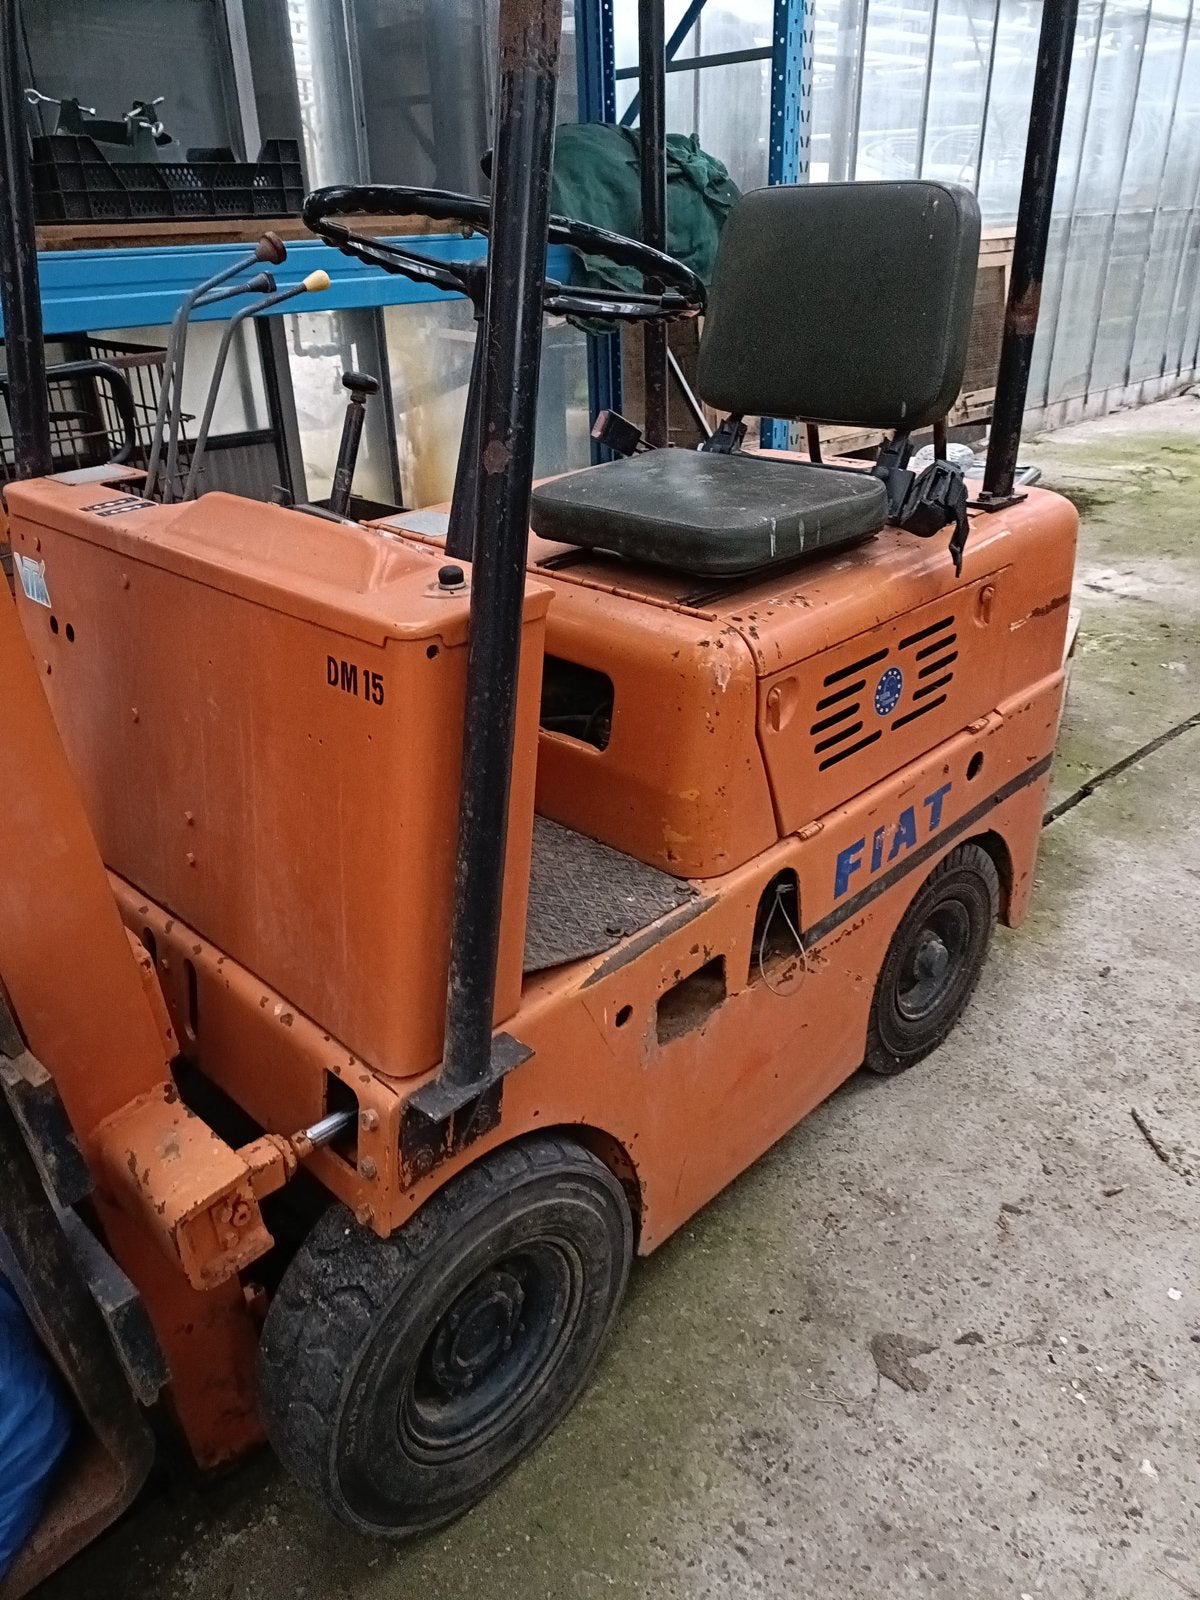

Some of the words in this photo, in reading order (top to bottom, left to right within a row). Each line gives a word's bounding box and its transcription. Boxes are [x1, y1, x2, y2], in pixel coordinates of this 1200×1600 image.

[327, 655, 358, 696] DM
[363, 669, 384, 706] 15
[834, 782, 952, 900] FIAT
